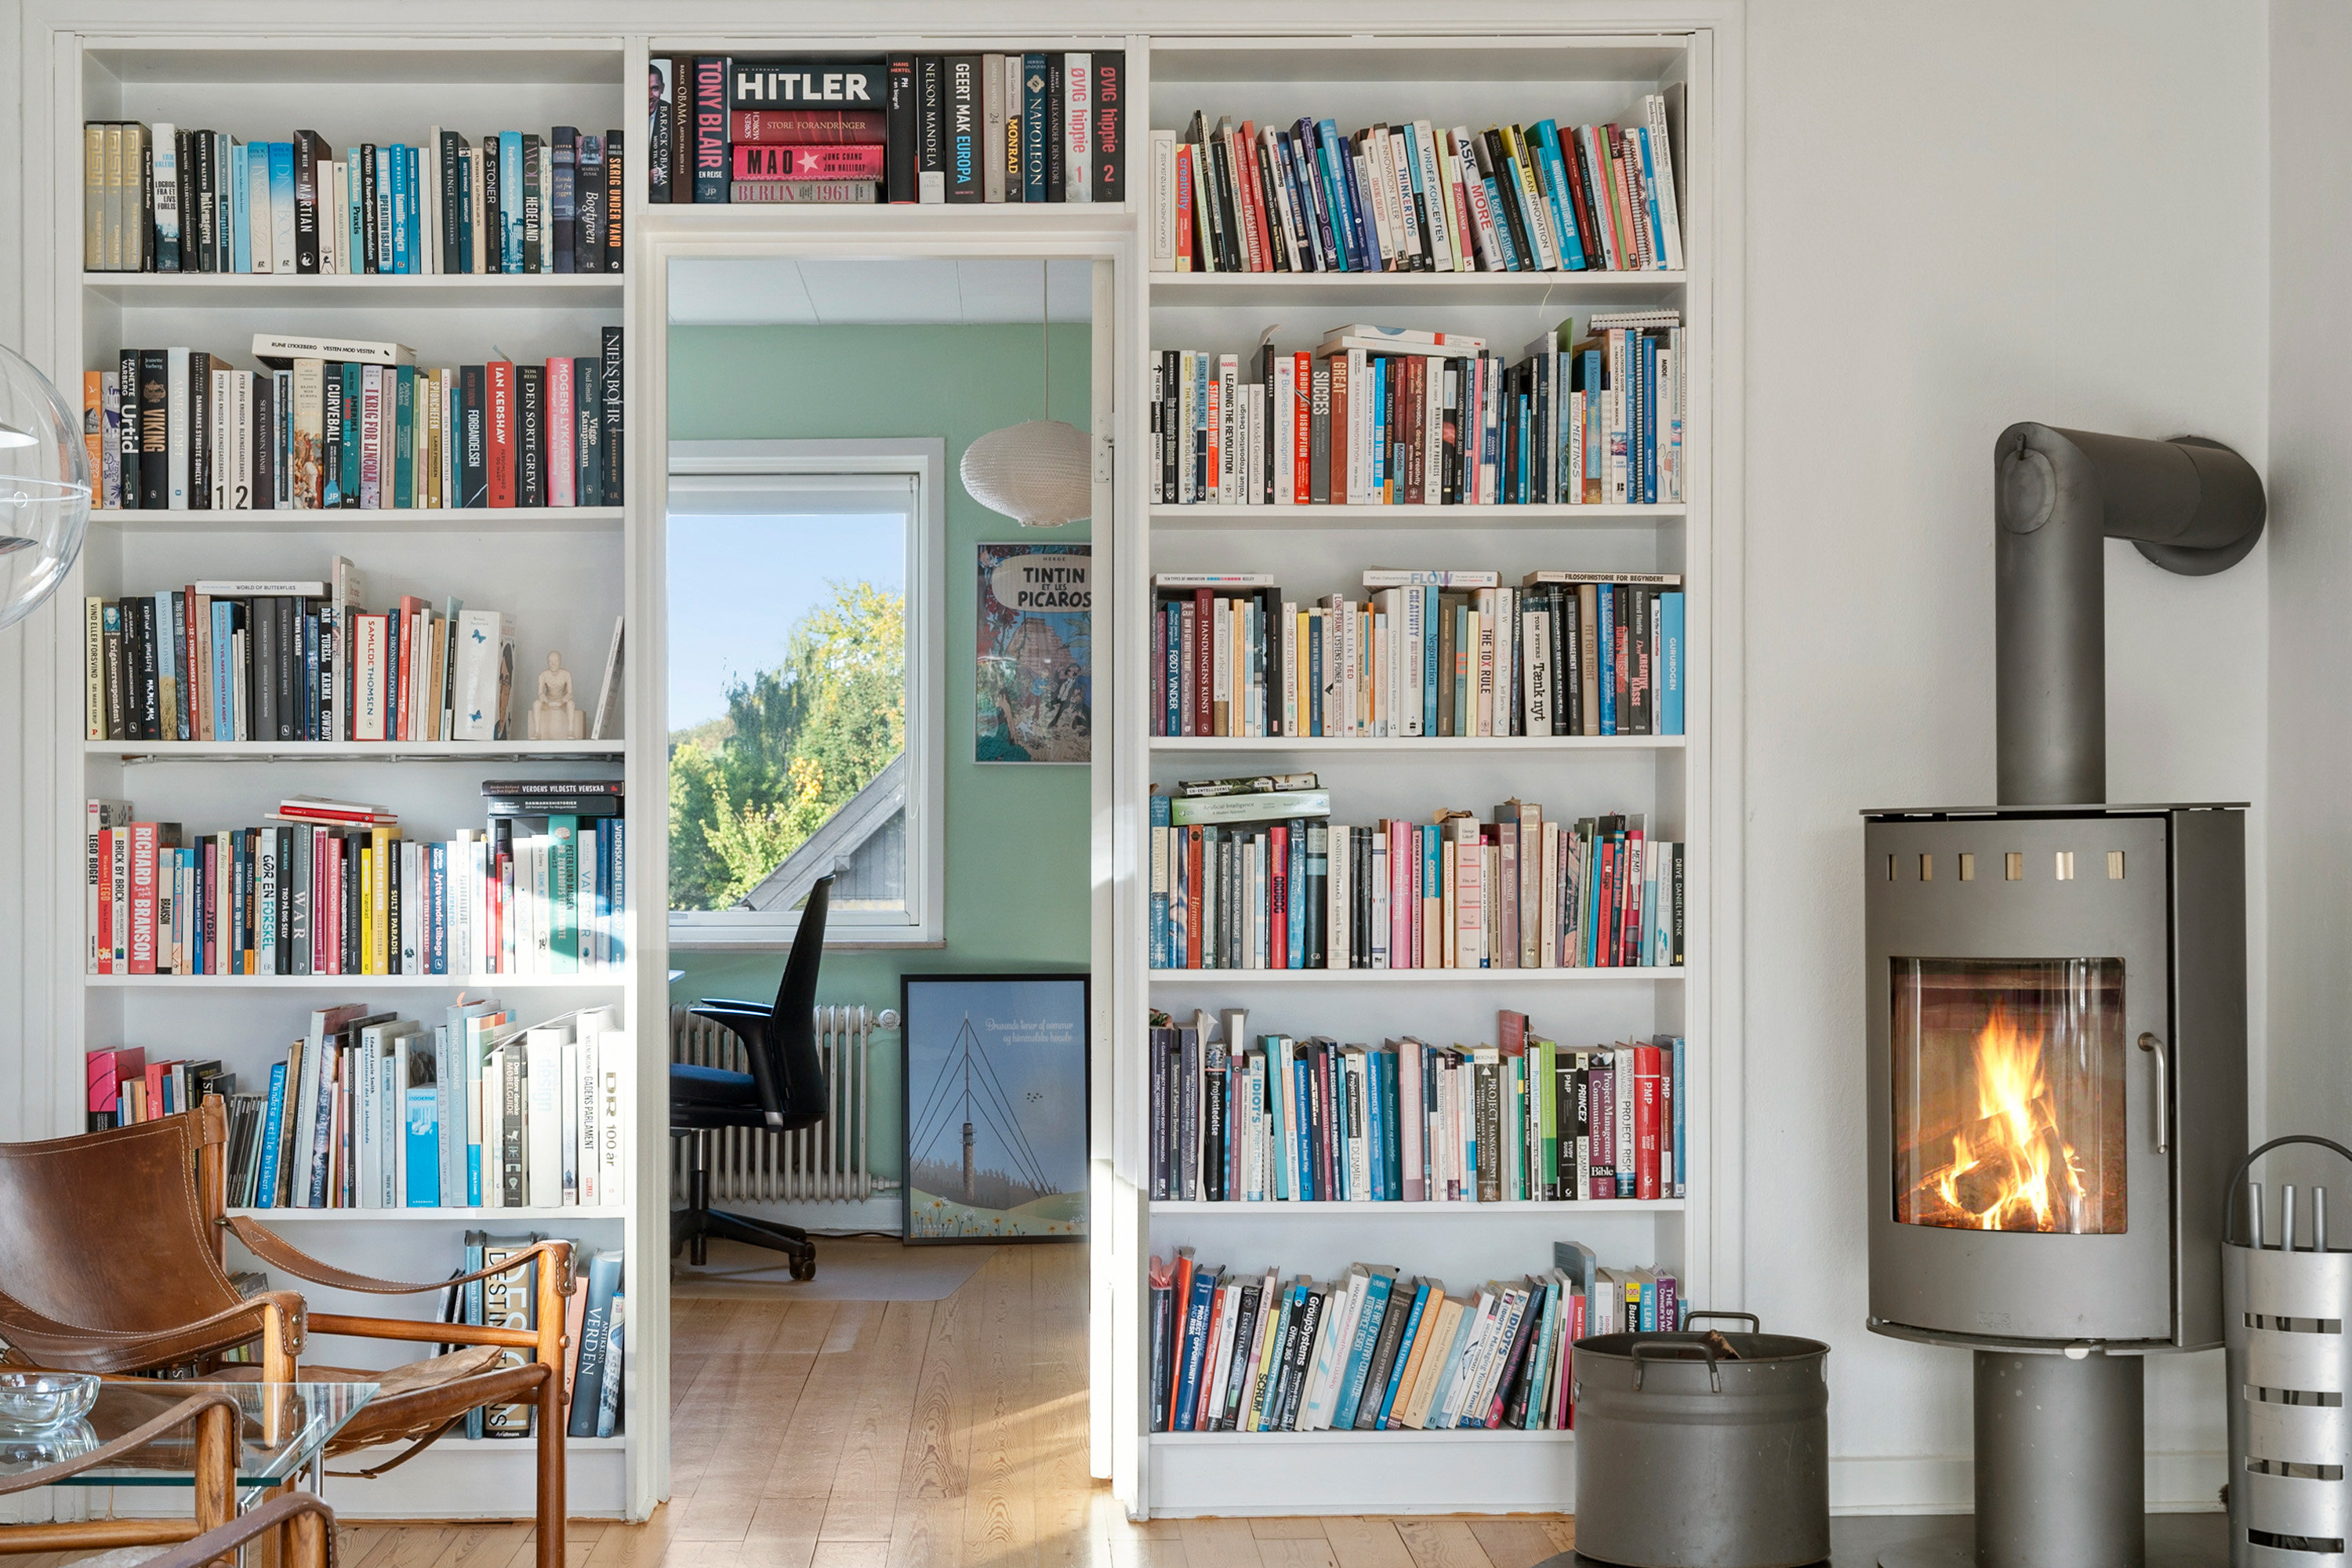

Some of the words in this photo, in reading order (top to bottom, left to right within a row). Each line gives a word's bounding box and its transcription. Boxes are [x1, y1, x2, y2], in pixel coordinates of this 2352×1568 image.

[699, 61, 722, 110] TONY
[738, 74, 871, 100] HITLER
[902, 78, 908, 88] PH
[925, 64, 935, 108] NELSON
[956, 64, 970, 101] GEERT
[1099, 67, 1118, 102] ØVIG
[659, 106, 668, 146] BARACK
[956, 105, 971, 133] MAK
[1098, 109, 1118, 153] hippie
[699, 114, 722, 168] BLAIR
[926, 112, 936, 167] MANDELA
[1007, 118, 1018, 174] MONRAD
[1029, 98, 1043, 186] NAPOLEON
[609, 158, 621, 185] SKRIG
[659, 149, 668, 185] OBAMA
[747, 150, 793, 174] MAO
[956, 136, 971, 183] EUROPA
[1103, 165, 1115, 183] 2
[1423, 147, 1435, 183] VINDER
[486, 160, 495, 203] STONER
[739, 185, 795, 201] BERLIN
[816, 185, 849, 201] 1961
[1178, 158, 1189, 210] creativity
[1458, 140, 1475, 170] ASK
[1471, 185, 1492, 230] MORE
[1551, 160, 1575, 237] INNOVATIONSMOTORVEJEN
[582, 191, 599, 244] Bogtyven
[609, 190, 621, 220] UNDER
[1398, 167, 1417, 237] THINKERTOYS
[1428, 185, 1444, 242] KONCEPTER
[1523, 170, 1536, 192] LEAN
[1530, 194, 1549, 249] INNOVATION
[609, 223, 621, 247] VAND
[606, 335, 619, 378] NIELS
[495, 367, 504, 387] IAN
[525, 383, 535, 408] DEN
[560, 364, 569, 414] MOGENS
[1312, 372, 1330, 415] SUCCES
[1333, 362, 1347, 394] GREAT
[327, 384, 340, 443] CURVEBALL
[430, 381, 440, 429] SPIONCHEFEN
[607, 379, 621, 424] BOHR
[1209, 385, 1218, 408] START
[122, 405, 139, 453] Urtid
[143, 408, 165, 452] VIKING
[496, 390, 505, 444] KERSHAW
[525, 412, 535, 450] SORTE
[589, 418, 598, 445] Viggo
[1209, 409, 1218, 429] WITH
[468, 409, 480, 466] FORBANDELSEN
[560, 419, 570, 485] LYKKETOFT
[581, 410, 590, 467] Kampmann
[1209, 430, 1218, 448] WHY
[1281, 420, 1290, 475] Development
[526, 453, 535, 492] GREVE
[236, 485, 248, 510] 2
[1022, 568, 1085, 583] TINTIN
[1410, 572, 1454, 585] FLOW
[321, 608, 331, 623] DAN
[1018, 591, 1091, 608] PICAROS
[1409, 590, 1419, 637] CREATIVITY
[1481, 629, 1492, 646] THE
[1169, 650, 1178, 674] FØDT
[1428, 633, 1437, 685] Negotiation
[1481, 650, 1492, 667] 10X
[109, 638, 120, 723] Krigskorrespondent
[321, 673, 331, 700] KARMA
[1169, 677, 1178, 710] VINDER
[1480, 670, 1491, 694] RULE
[1534, 662, 1545, 698] Tænk
[1632, 677, 1640, 706] KLASSE
[321, 710, 331, 740] COWBOY
[1530, 701, 1546, 721] nyt
[89, 834, 98, 855] LEGO
[115, 840, 124, 863] BRICK
[135, 827, 151, 884] RICHARD
[89, 858, 98, 885] BOGEN
[115, 866, 124, 875] BY
[263, 855, 274, 878] GØR
[1602, 860, 1612, 890] nudge
[115, 879, 124, 902] BRICK
[263, 884, 274, 898] EN
[1273, 877, 1285, 913] ORDBOG
[134, 898, 151, 960] BRANSON
[160, 898, 171, 924] BRANSON
[263, 901, 274, 950] FORSKEL
[293, 891, 306, 939] WAR
[1190, 897, 1200, 938] Hjernerum
[583, 1076, 593, 1105] GADENS
[606, 1072, 617, 1116] DR
[1252, 1079, 1262, 1123] IDIOT'S
[1488, 1078, 1497, 1123] PROJECT
[1602, 1072, 1613, 1104] Project
[1211, 1080, 1220, 1136] Projektledelse
[1592, 1080, 1602, 1156] Communications
[1622, 1101, 1632, 1144] PROJECT
[584, 1106, 593, 1149] PARLAMENT
[606, 1123, 617, 1149] 100
[1602, 1105, 1613, 1164] Management
[606, 1152, 618, 1167] år
[1592, 1167, 1613, 1176] Bible
[1622, 1149, 1632, 1171] RISK
[1643, 1290, 1652, 1305] THE
[1237, 1311, 1251, 1353] ESSENTIAL
[1296, 1296, 1319, 1366] GroupSystems
[1643, 1308, 1652, 1327] LEAN
[581, 1307, 602, 1376] VERDEN
[597, 1320, 608, 1363] ANTIKKENS
[1232, 1356, 1243, 1385] SCRUM
[1253, 1373, 1267, 1412] SCRUM
